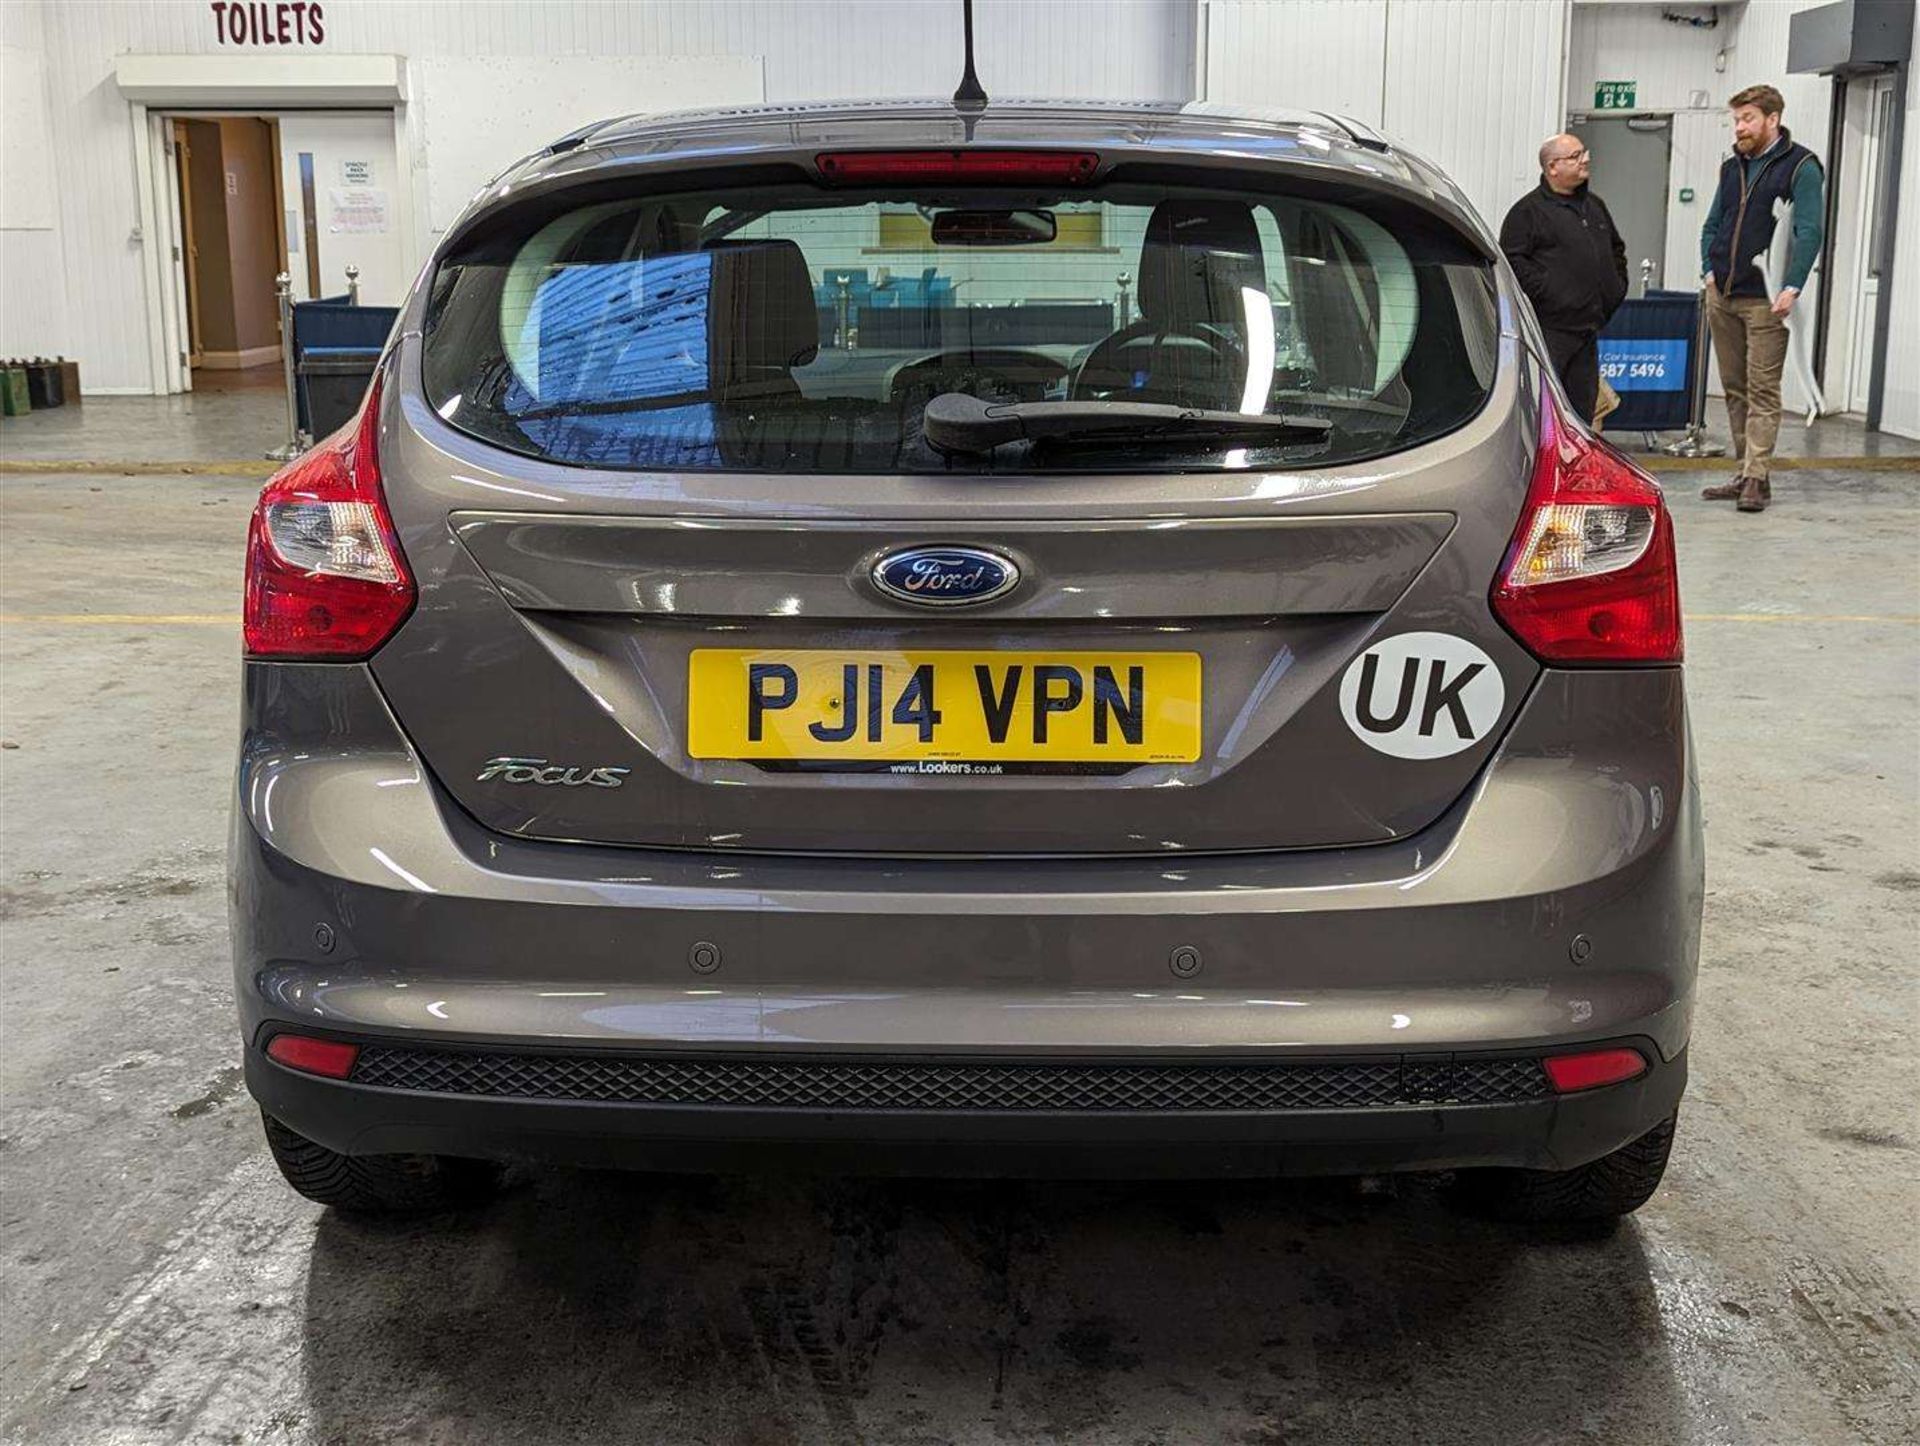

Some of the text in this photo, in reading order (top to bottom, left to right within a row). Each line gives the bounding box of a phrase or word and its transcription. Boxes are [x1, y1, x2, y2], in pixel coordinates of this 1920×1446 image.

[211, 2, 324, 45] TOILETS
[1595, 82, 1636, 93] Fire exit
[1603, 353, 1621, 362] Car
[1622, 353, 1666, 362] Insurance
[1600, 363, 1665, 378] 587 5496
[904, 558, 985, 591] Ford
[748, 664, 1144, 745] PJ14 VPN
[1356, 653, 1488, 740] UK
[890, 761, 1003, 774] www.Lookers.co.uk
